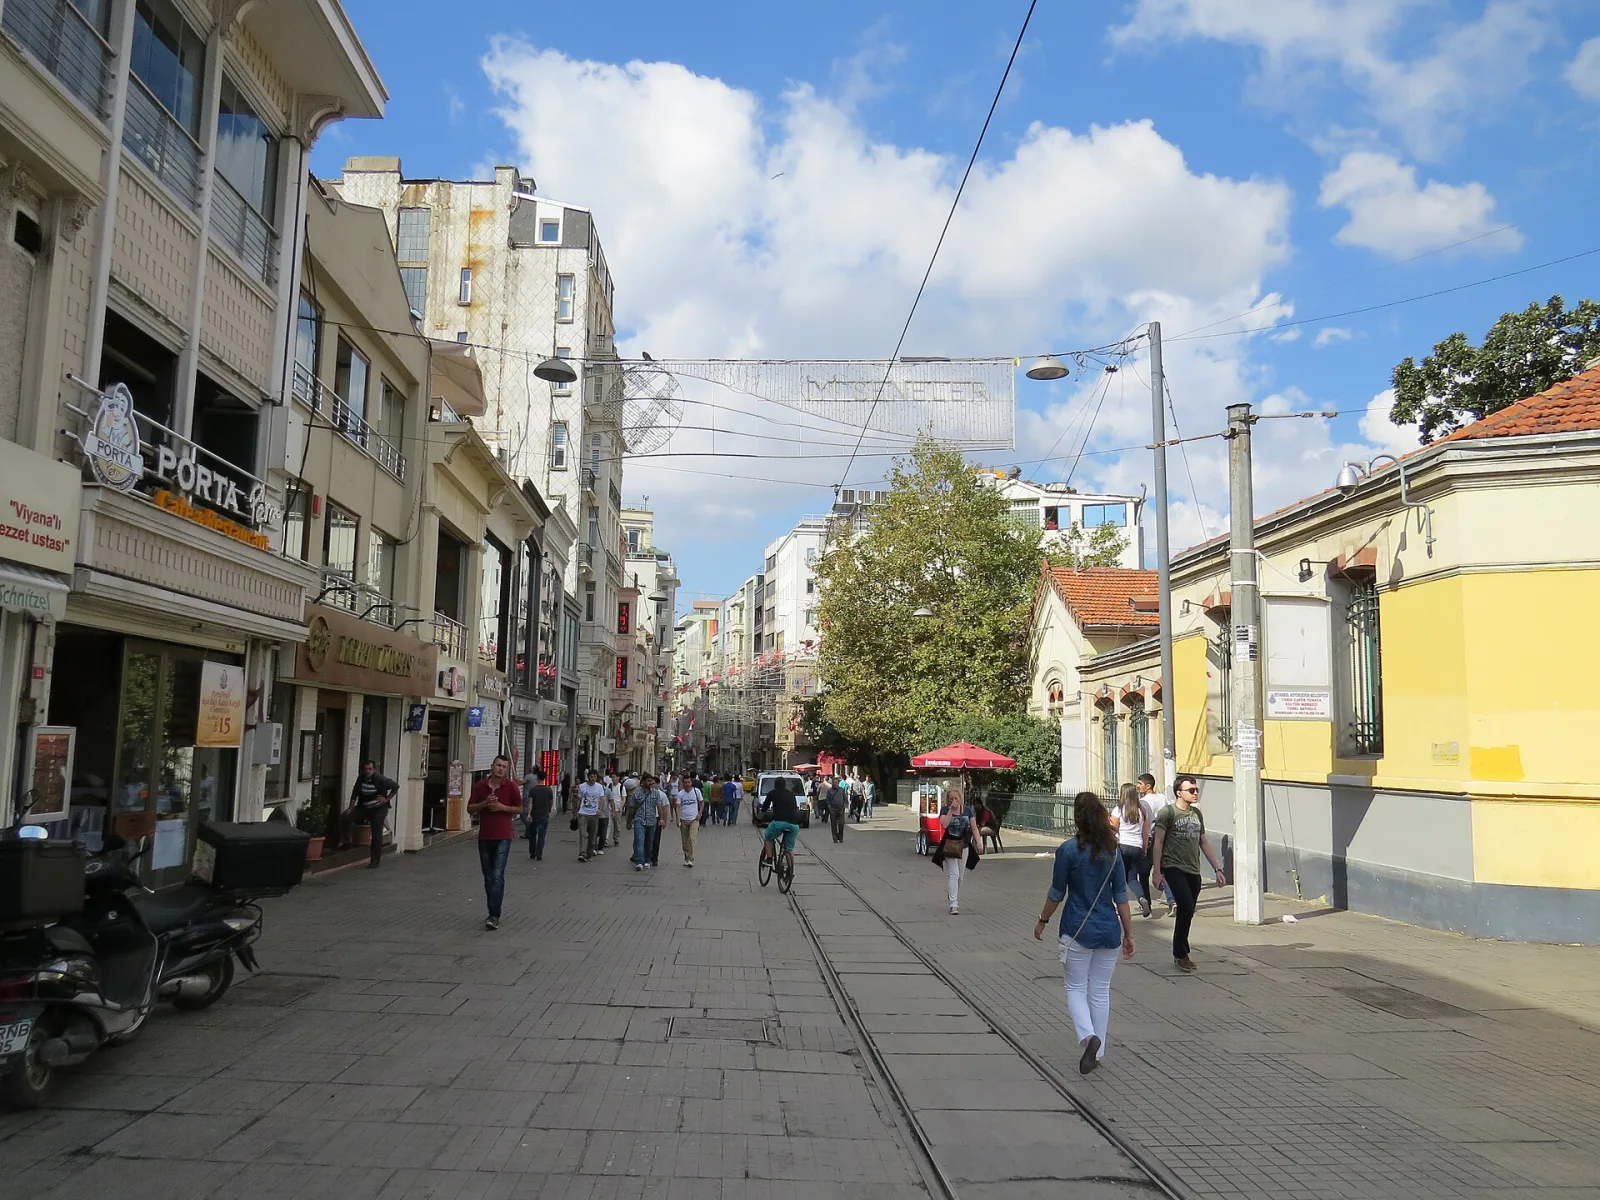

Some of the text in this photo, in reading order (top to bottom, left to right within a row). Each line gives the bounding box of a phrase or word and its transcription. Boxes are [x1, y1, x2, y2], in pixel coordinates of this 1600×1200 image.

[97, 440, 133, 468] PORTA
[159, 444, 240, 514] PORTA
[0, 1023, 30, 1040] RNB
